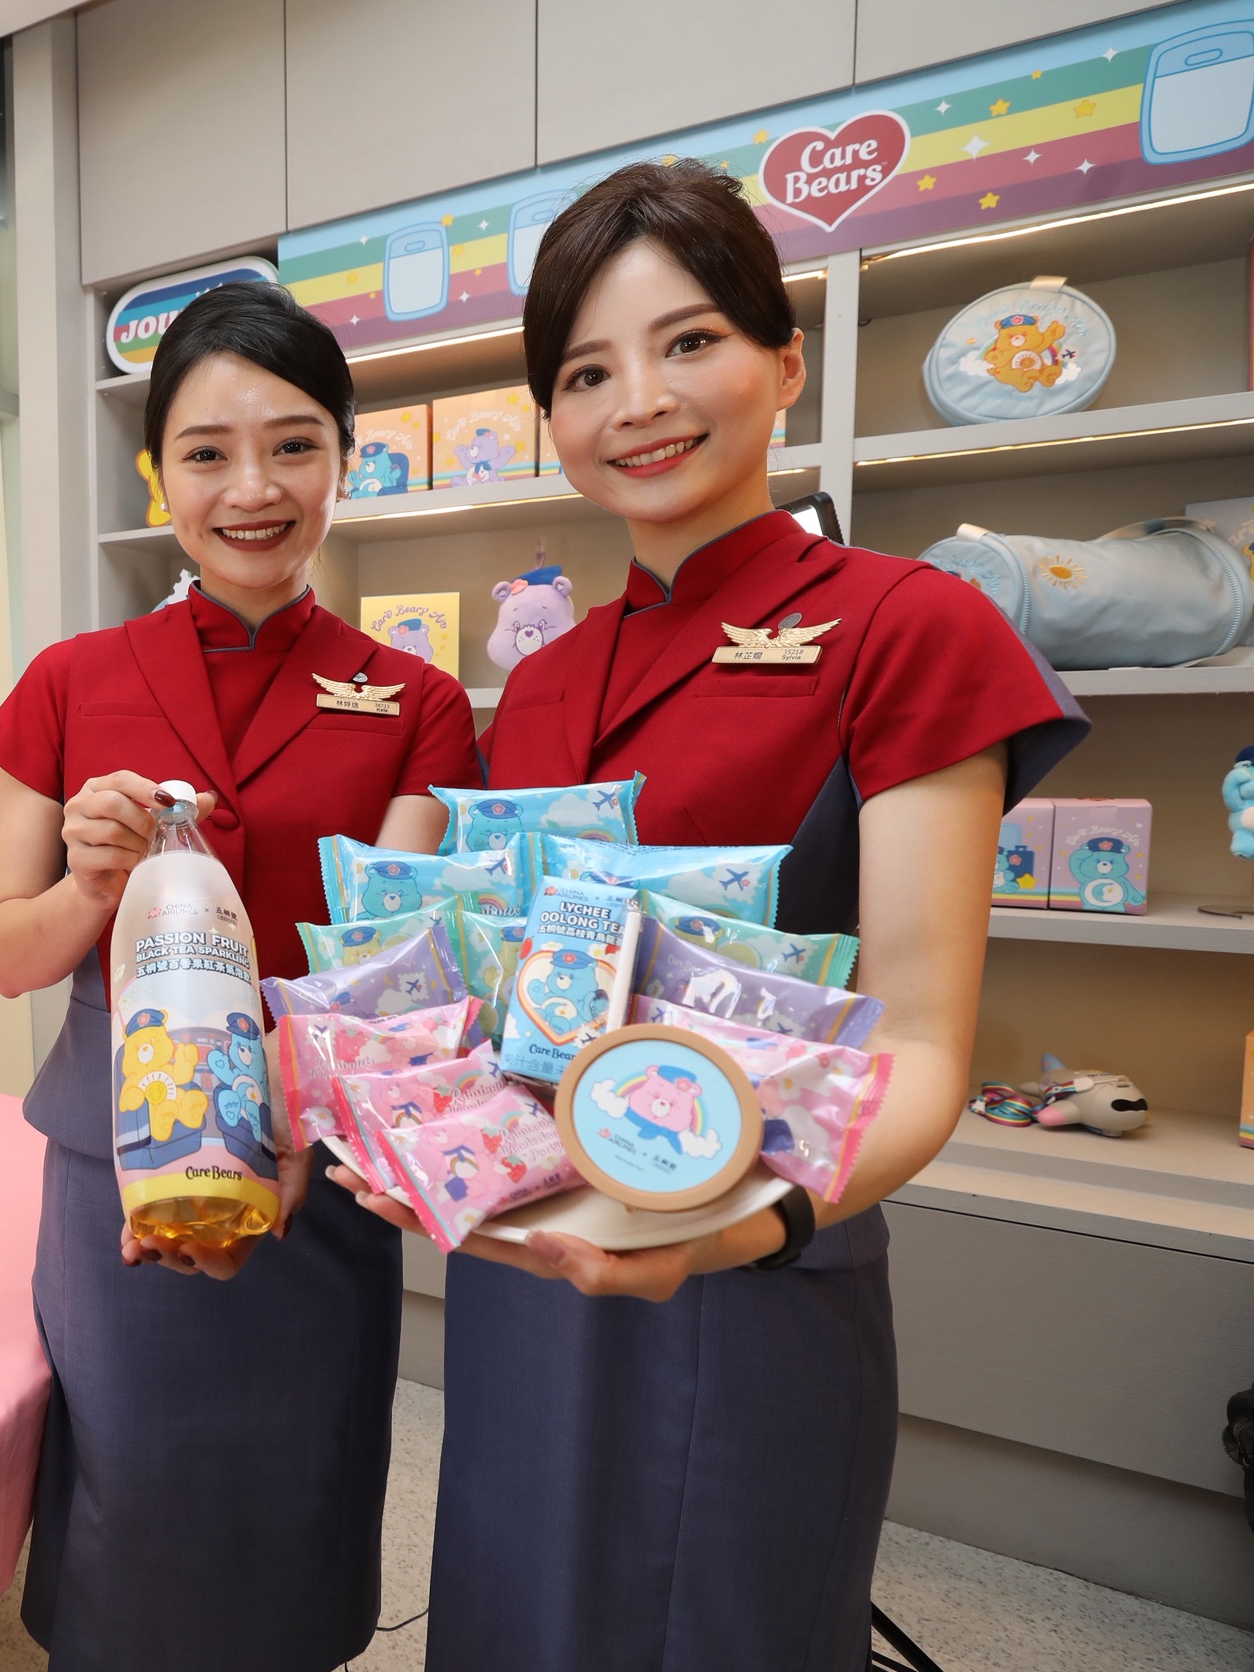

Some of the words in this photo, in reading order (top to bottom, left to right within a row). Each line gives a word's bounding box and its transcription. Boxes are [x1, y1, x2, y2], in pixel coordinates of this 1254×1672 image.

[800, 139, 878, 173] Care
[785, 164, 883, 204] Bears
[370, 609, 393, 632] Care
[557, 892, 589, 902] AIRLINES
[561, 888, 585, 896] CHINA
[162, 908, 198, 916] AIRLINES
[560, 901, 611, 919] LYCHEE
[541, 911, 599, 930] OOLONG
[136, 932, 206, 953] PASSION
[211, 934, 248, 959] FRUIT
[136, 947, 170, 964] BLACK
[173, 946, 196, 955] TEA
[198, 946, 250, 969] SPARKLING
[529, 1044, 551, 1056] Care
[552, 1048, 576, 1060] Bear
[186, 1166, 210, 1180] Care
[212, 1165, 242, 1181] Bears
